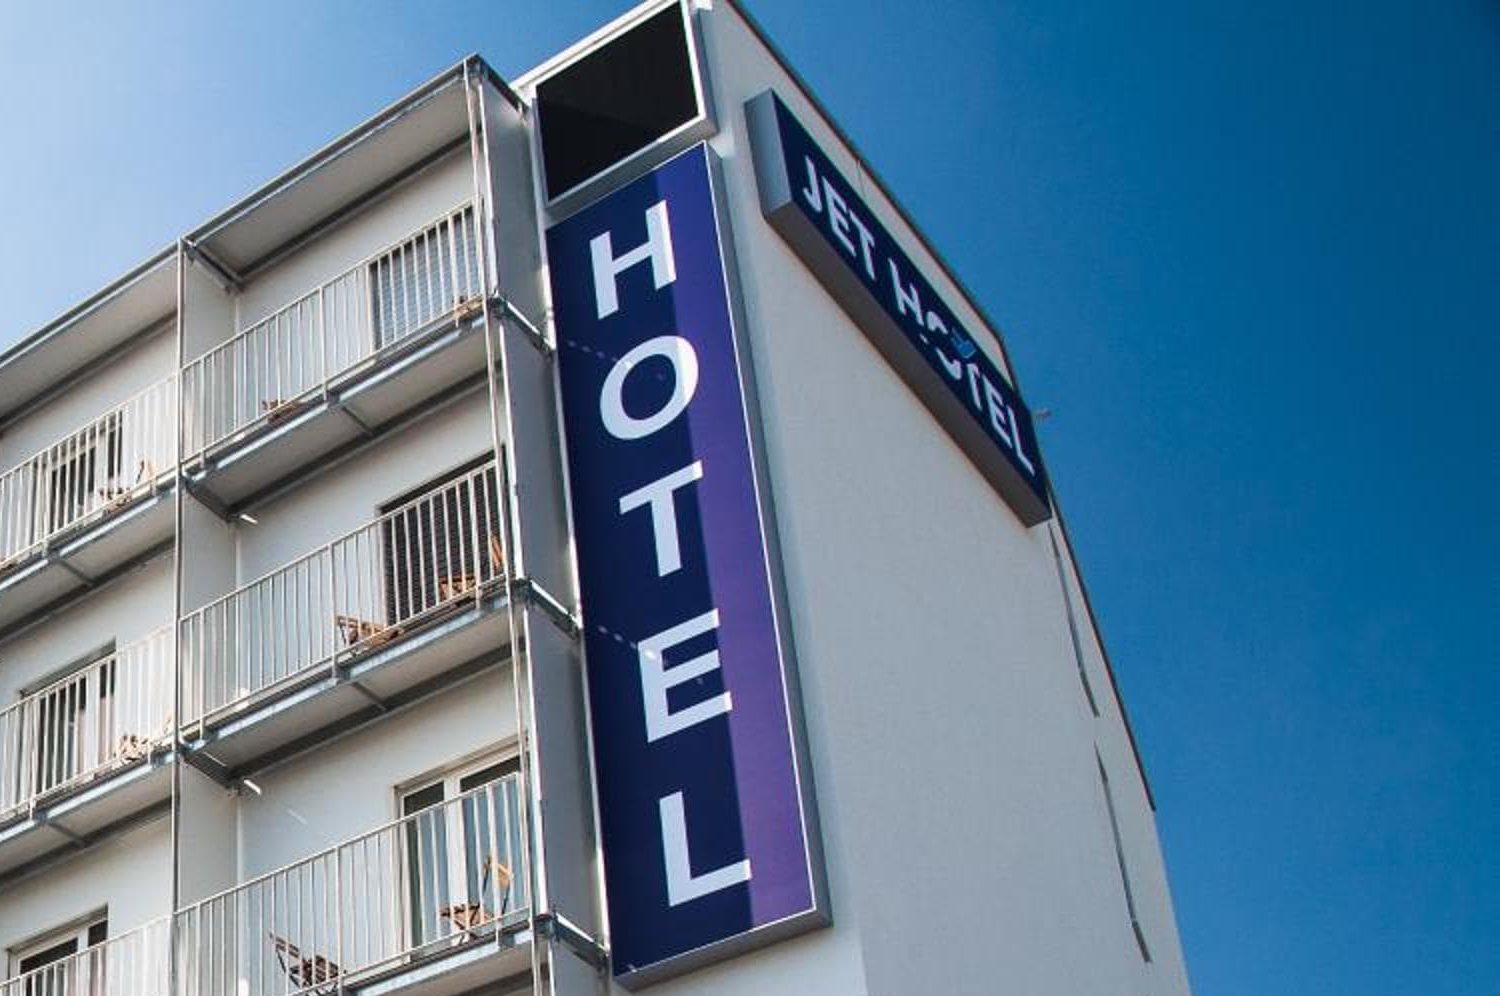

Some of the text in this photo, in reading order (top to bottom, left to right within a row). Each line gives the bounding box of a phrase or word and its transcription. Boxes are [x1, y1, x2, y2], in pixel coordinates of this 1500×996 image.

[589, 200, 752, 907] HOTEL
[803, 155, 1035, 476] JET HOTEL
